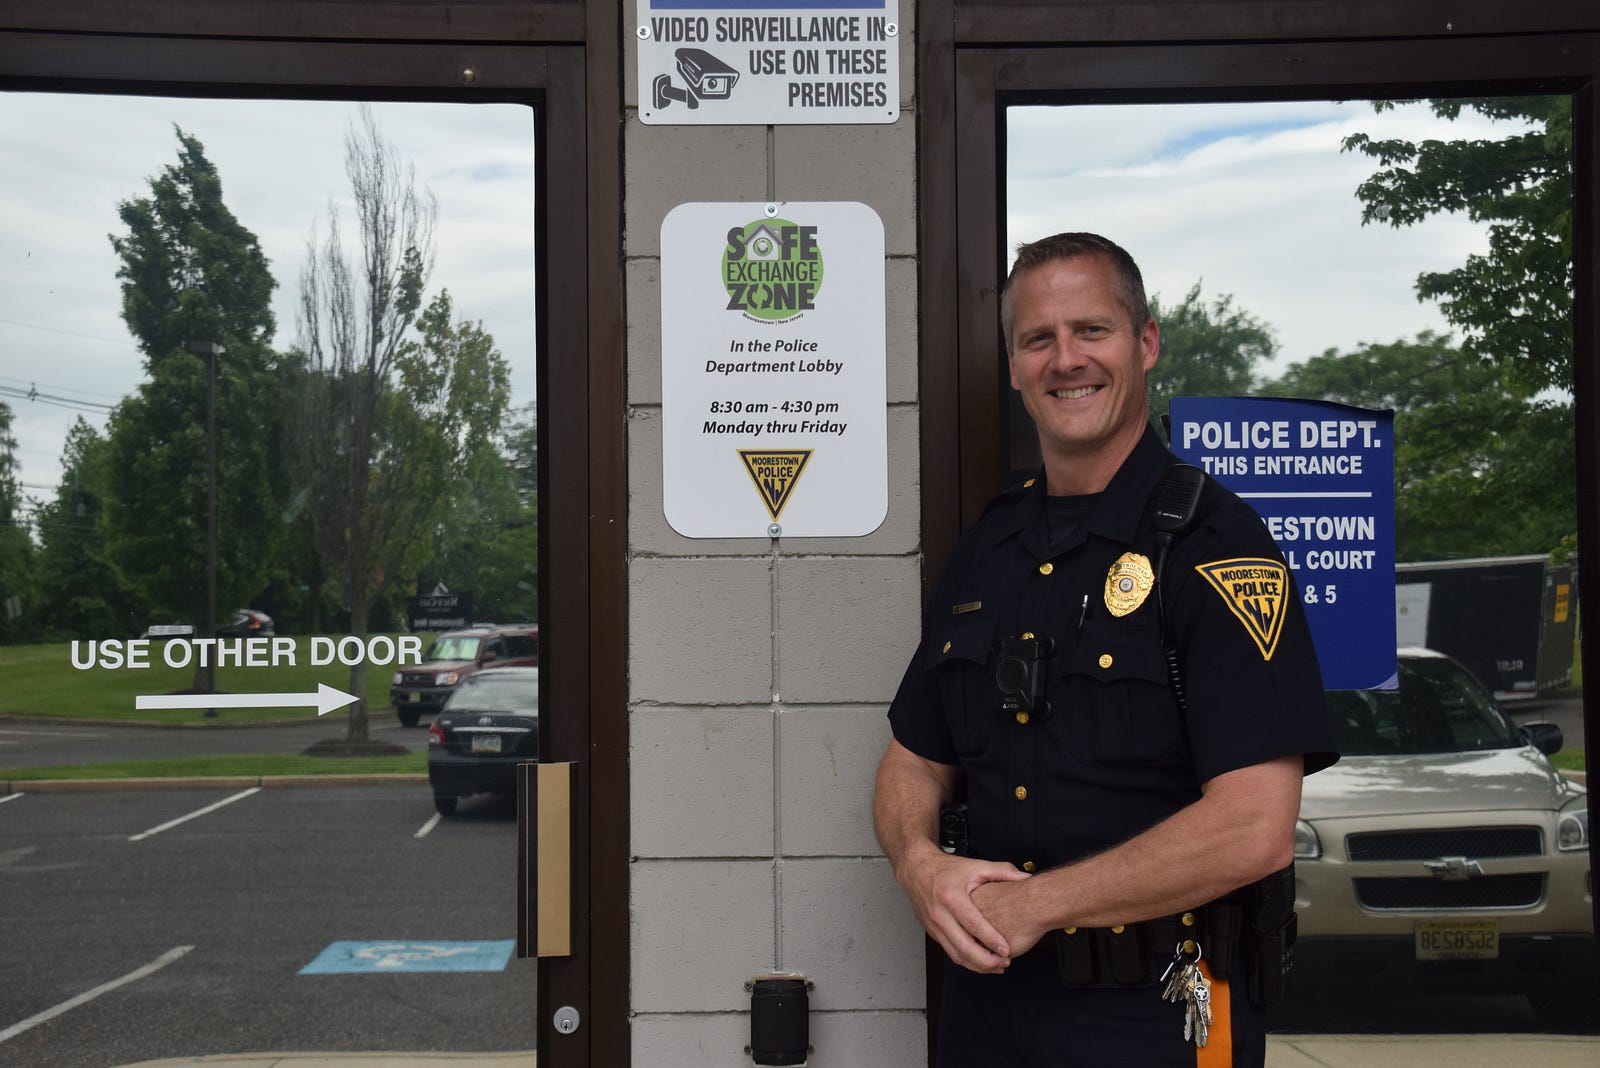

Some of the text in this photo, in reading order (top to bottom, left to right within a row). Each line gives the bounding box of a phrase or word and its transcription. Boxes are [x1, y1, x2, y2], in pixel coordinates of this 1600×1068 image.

[651, 16, 886, 43] VIDEO SURVEILLANCE IN
[750, 49, 887, 75] USE ON THESE
[788, 82, 887, 107] PREMISES
[727, 226, 818, 261] SAFE
[727, 262, 818, 282] EXCHANGE
[726, 283, 815, 310] ZONE
[730, 340, 818, 352] In the Police
[706, 360, 844, 375] Department Lobby
[710, 401, 742, 413] 8:30
[745, 405, 769, 413] am
[781, 401, 813, 413] 4:30
[815, 404, 839, 415] pm
[703, 421, 847, 436] Monday thru Friday
[1183, 420, 1382, 449] POLICE DEPT.
[751, 457, 799, 466] MOORESTOWN
[1201, 456, 1362, 475] THIS ENTRANCE
[758, 466, 793, 478] POLICE
[763, 478, 787, 506] NJ
[1261, 516, 1375, 541] ESTOWN
[1306, 550, 1375, 570] COURT
[1220, 568, 1281, 582] MOORESTOWN
[1232, 581, 1280, 598] POLICE
[1304, 585, 1337, 604] & 5
[71, 635, 422, 669] USE OTHER DOOR
